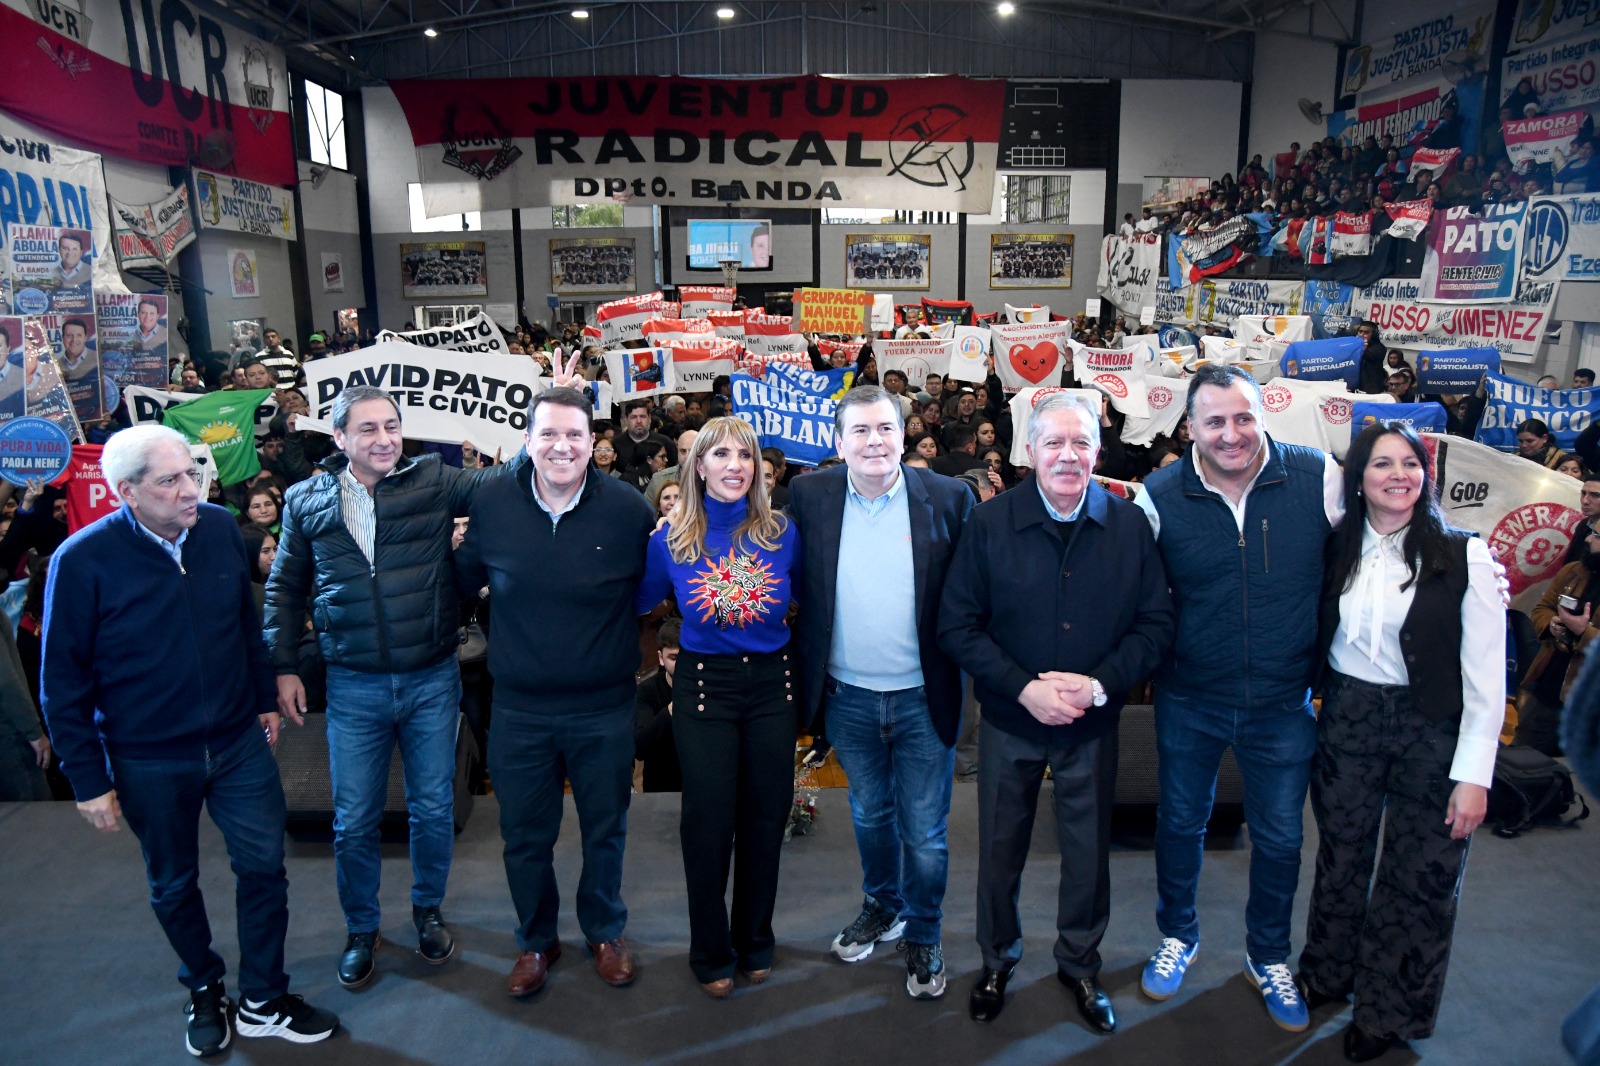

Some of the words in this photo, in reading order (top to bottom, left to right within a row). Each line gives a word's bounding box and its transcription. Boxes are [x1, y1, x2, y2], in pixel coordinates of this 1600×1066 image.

[37, 0, 80, 39] UCR
[1393, 15, 1453, 51] PARTIDO
[1369, 28, 1469, 78] JUSTICIALISTA
[1508, 51, 1548, 75] Partido
[120, 0, 232, 131] UCR
[1407, 57, 1441, 79] BANDA
[1520, 60, 1596, 97] USSO
[250, 87, 269, 108] UCR
[529, 80, 889, 118] JUVENTUD
[1507, 114, 1568, 135] ZAMORA
[534, 128, 882, 167] RADICAL
[231, 178, 272, 205] PARTIDO
[692, 178, 842, 200] BANDA
[221, 195, 283, 225] JUSTICIALISTA
[12, 227, 57, 240] LLAMIL
[239, 220, 248, 231] LA
[250, 221, 273, 235] BANDA
[1443, 219, 1519, 253] PATO
[14, 240, 58, 252] ABDALA
[1441, 267, 1474, 280] FRENTE
[1228, 282, 1269, 301] PARTIDO
[97, 306, 137, 318] ABDALA
[747, 311, 793, 326] ZAMO
[803, 305, 858, 320] NAHUEL
[1369, 303, 1430, 332] RUSSO
[440, 320, 493, 346] PATO
[620, 322, 643, 333] LYNNE
[1442, 308, 1544, 341] JIMENEZ
[884, 348, 916, 356] FUERZA
[1087, 351, 1134, 366] ZAMORA
[1301, 357, 1335, 365] PARTIDO
[683, 372, 716, 382] LYNNE
[767, 361, 830, 393] UECO
[1301, 360, 1355, 374] JUSTICIALISTA
[1432, 363, 1489, 371] JUSTICIALISTA
[317, 363, 430, 405] DAVID
[433, 368, 533, 410] PATO
[1486, 377, 1592, 409] CHUECO
[733, 379, 837, 418] CHUE
[1153, 393, 1167, 402] 83
[1266, 391, 1285, 405] 83
[429, 395, 528, 431] CIVICO
[1330, 404, 1347, 417] 83
[5, 422, 44, 437] ASOCIACION
[45, 426, 59, 438] CIVIL
[763, 409, 836, 449] BLAN
[1, 440, 33, 452] PURA
[2, 457, 33, 468] PAOLA
[35, 457, 60, 468] NEME
[1450, 482, 1489, 503] GOB
